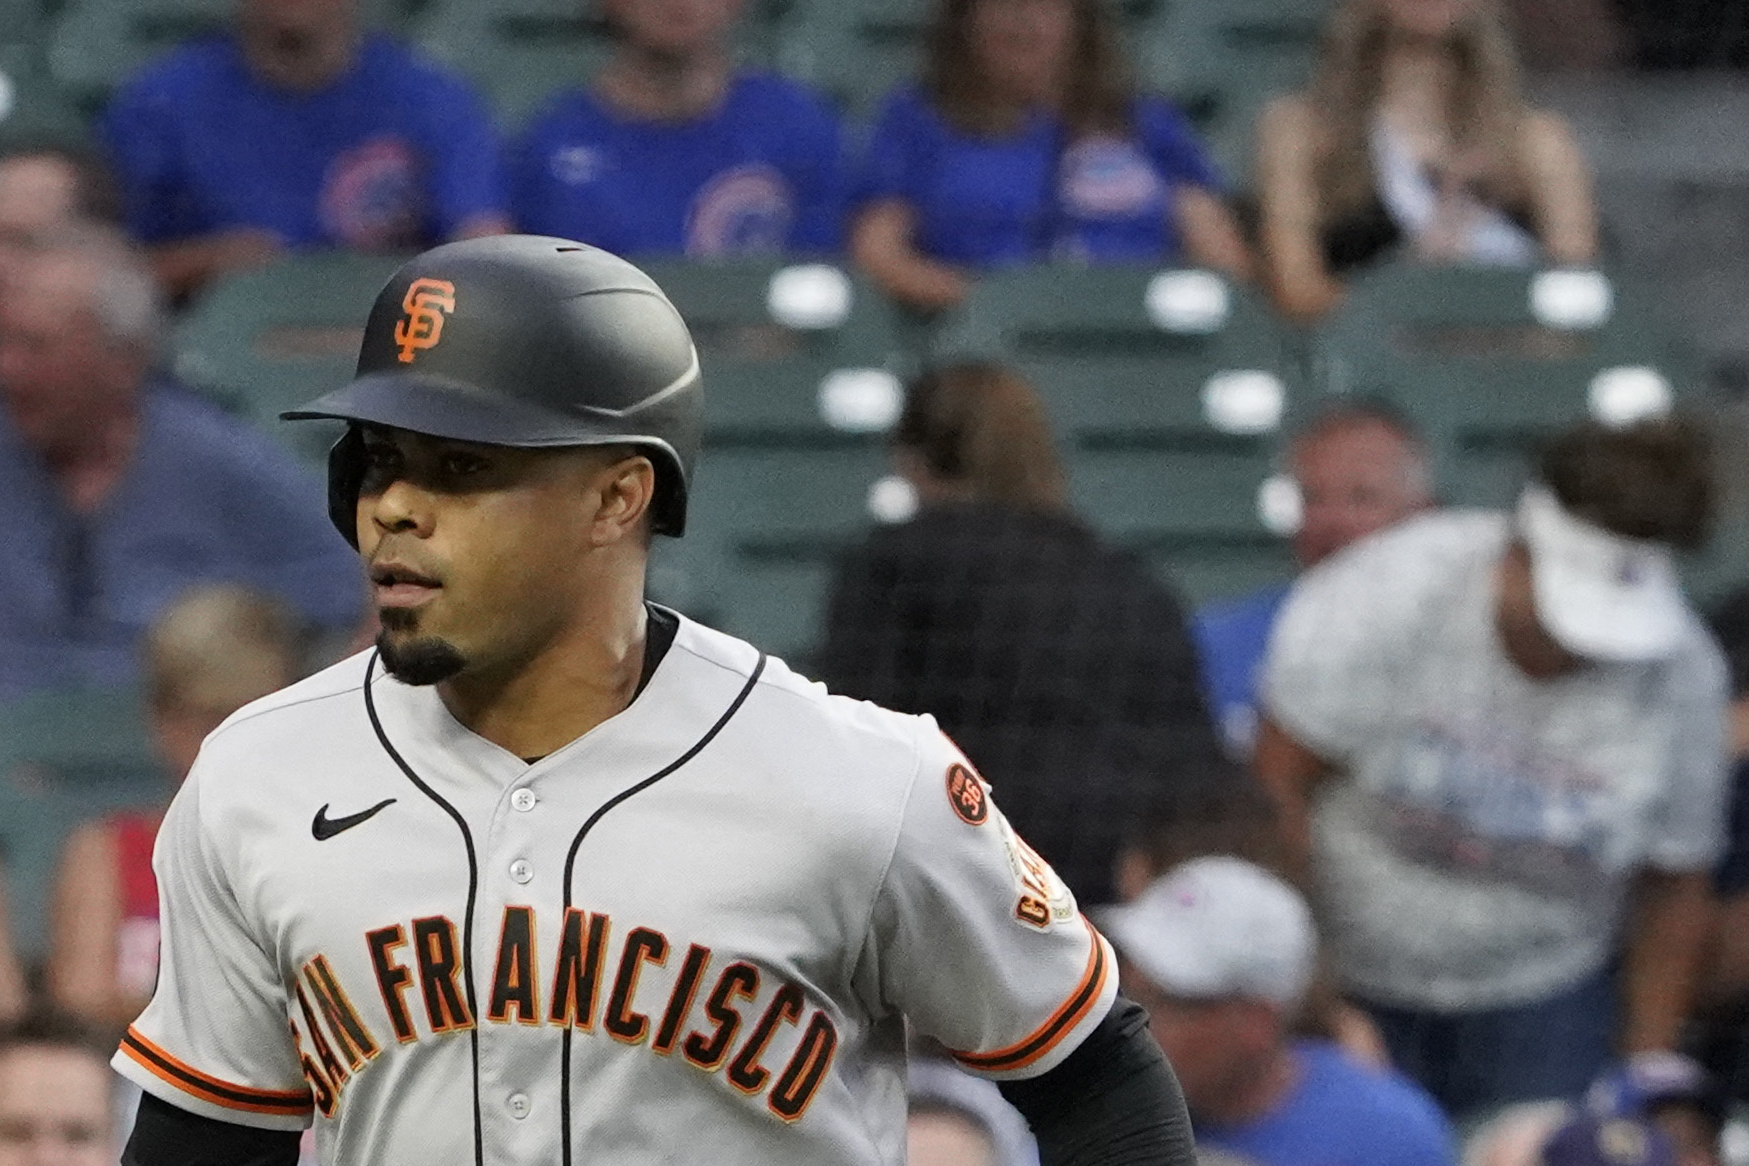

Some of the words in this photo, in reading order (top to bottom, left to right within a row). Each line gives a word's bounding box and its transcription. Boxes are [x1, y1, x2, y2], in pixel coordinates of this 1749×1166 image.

[961, 777, 982, 817] 36
[290, 953, 380, 1120] SAN
[365, 905, 839, 1125] FRANCISCO
